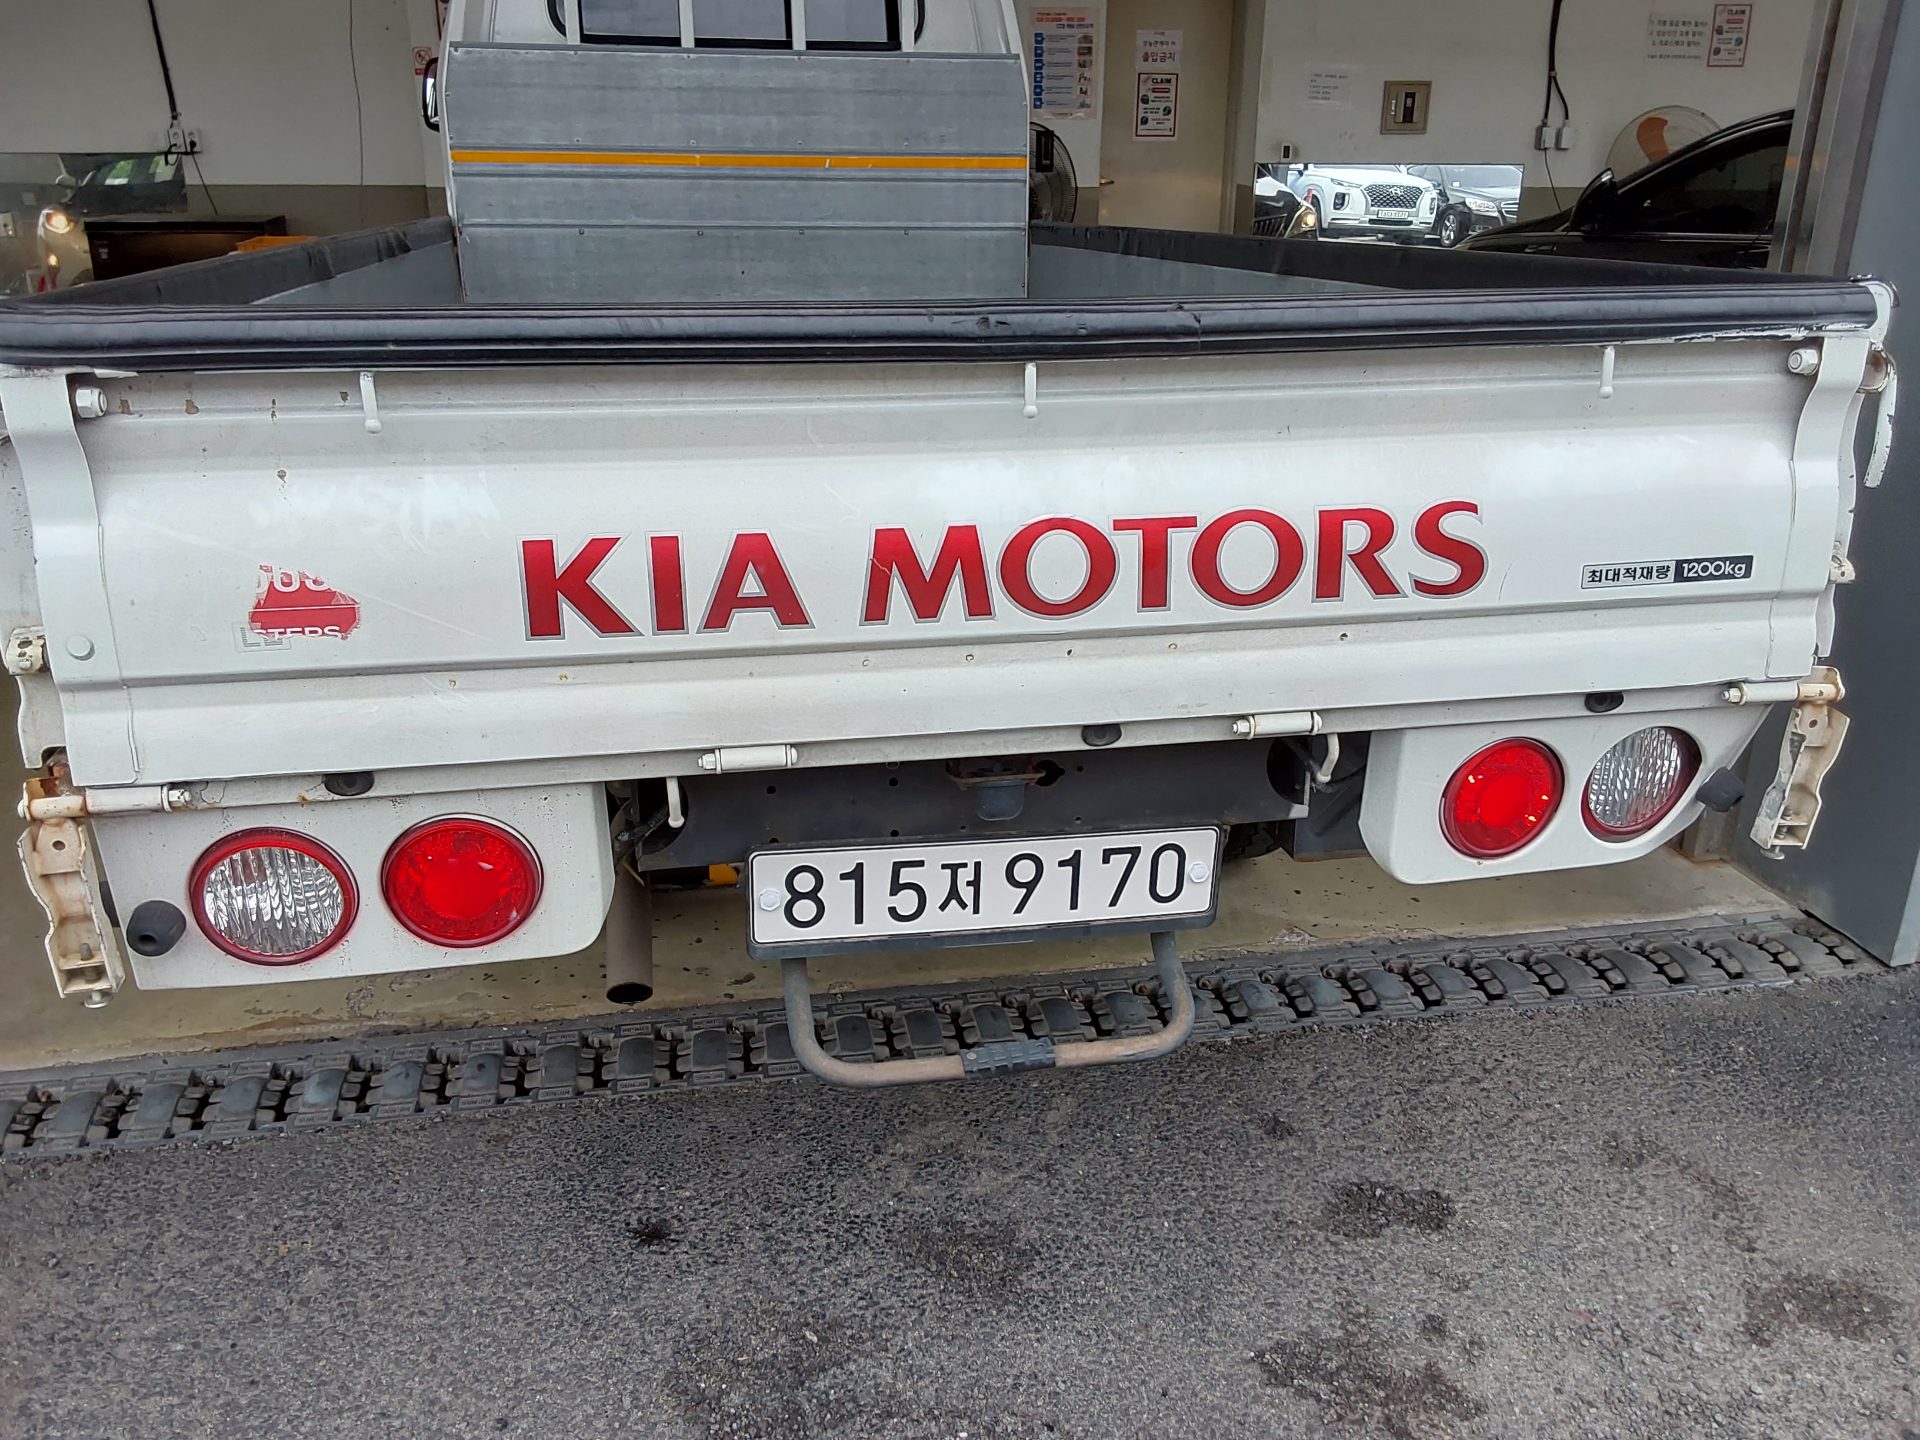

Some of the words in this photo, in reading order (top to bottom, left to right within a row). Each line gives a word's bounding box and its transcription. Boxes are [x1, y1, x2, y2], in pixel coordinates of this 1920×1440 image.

[1142, 51, 1176, 63] 출입금지
[1151, 77, 1172, 85] CLAIM
[517, 531, 815, 641] KIA
[859, 496, 1488, 626] MOTORS
[1587, 564, 1671, 584] 최대적재량
[1681, 560, 1746, 578] 1200kg
